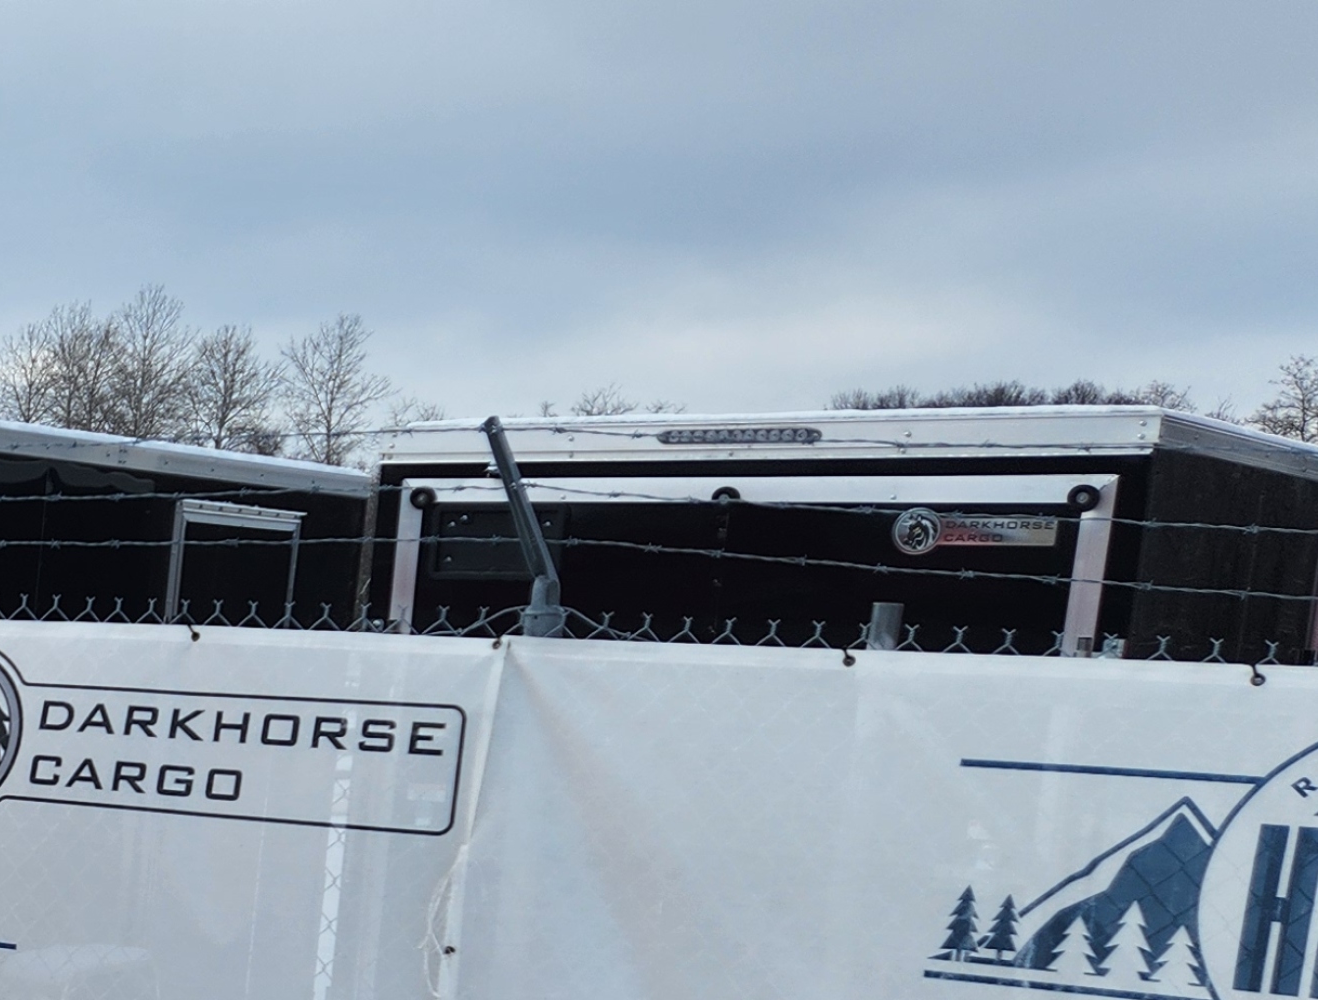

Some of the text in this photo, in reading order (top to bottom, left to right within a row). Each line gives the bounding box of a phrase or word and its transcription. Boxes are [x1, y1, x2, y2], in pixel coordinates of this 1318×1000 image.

[943, 533, 1003, 543] CARGO
[945, 520, 1055, 530] DARKHORSE
[38, 700, 447, 757] DARKHORSE
[28, 755, 243, 802] CARGO
